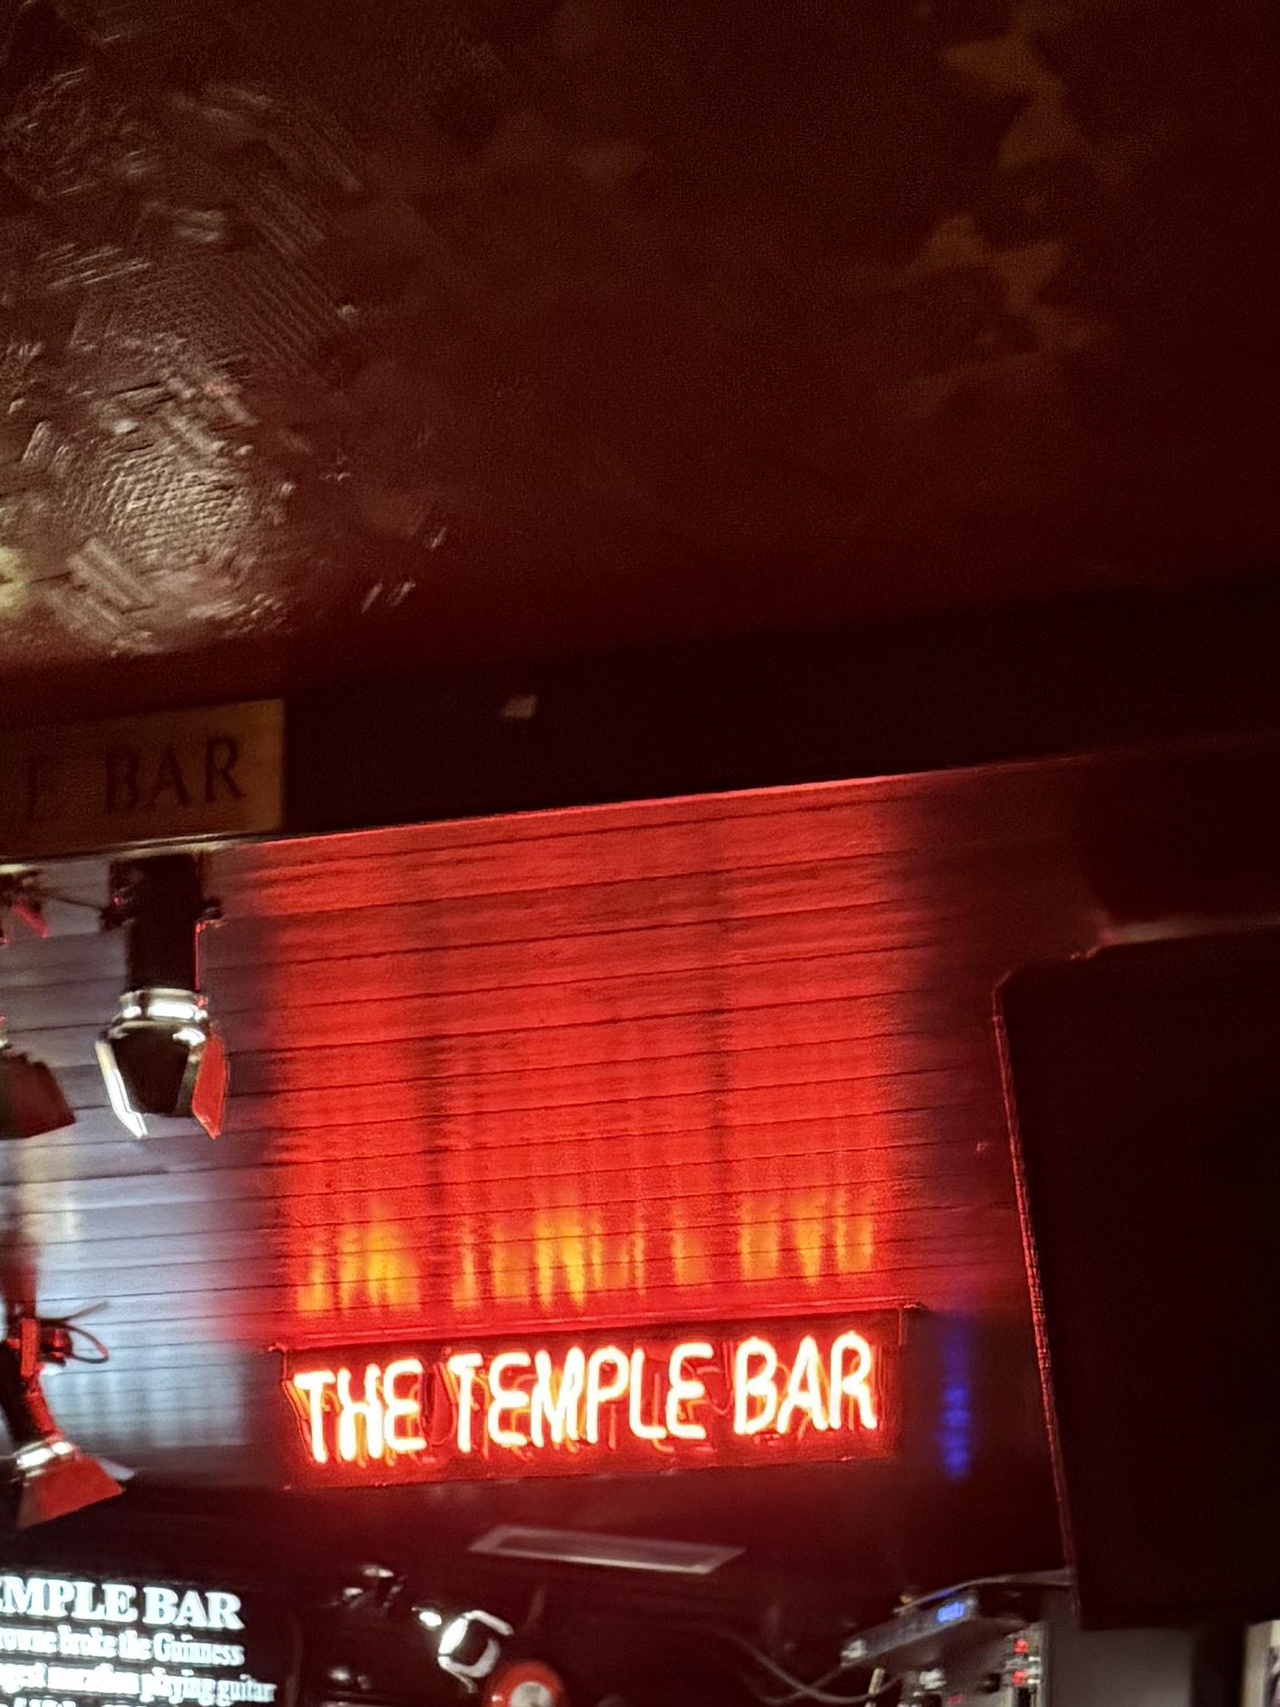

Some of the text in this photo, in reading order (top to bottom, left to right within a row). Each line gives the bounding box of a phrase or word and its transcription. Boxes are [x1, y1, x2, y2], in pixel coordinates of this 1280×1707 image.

[103, 734, 246, 814] BAR
[293, 1332, 877, 1463] THE TEMPLE BAR
[142, 1586, 245, 1630] BAR
[58, 1624, 118, 1658] broke
[118, 1629, 153, 1660] the
[153, 1632, 245, 1666] Guinness
[140, 1666, 216, 1706] playing
[216, 1674, 277, 1707] guitar
